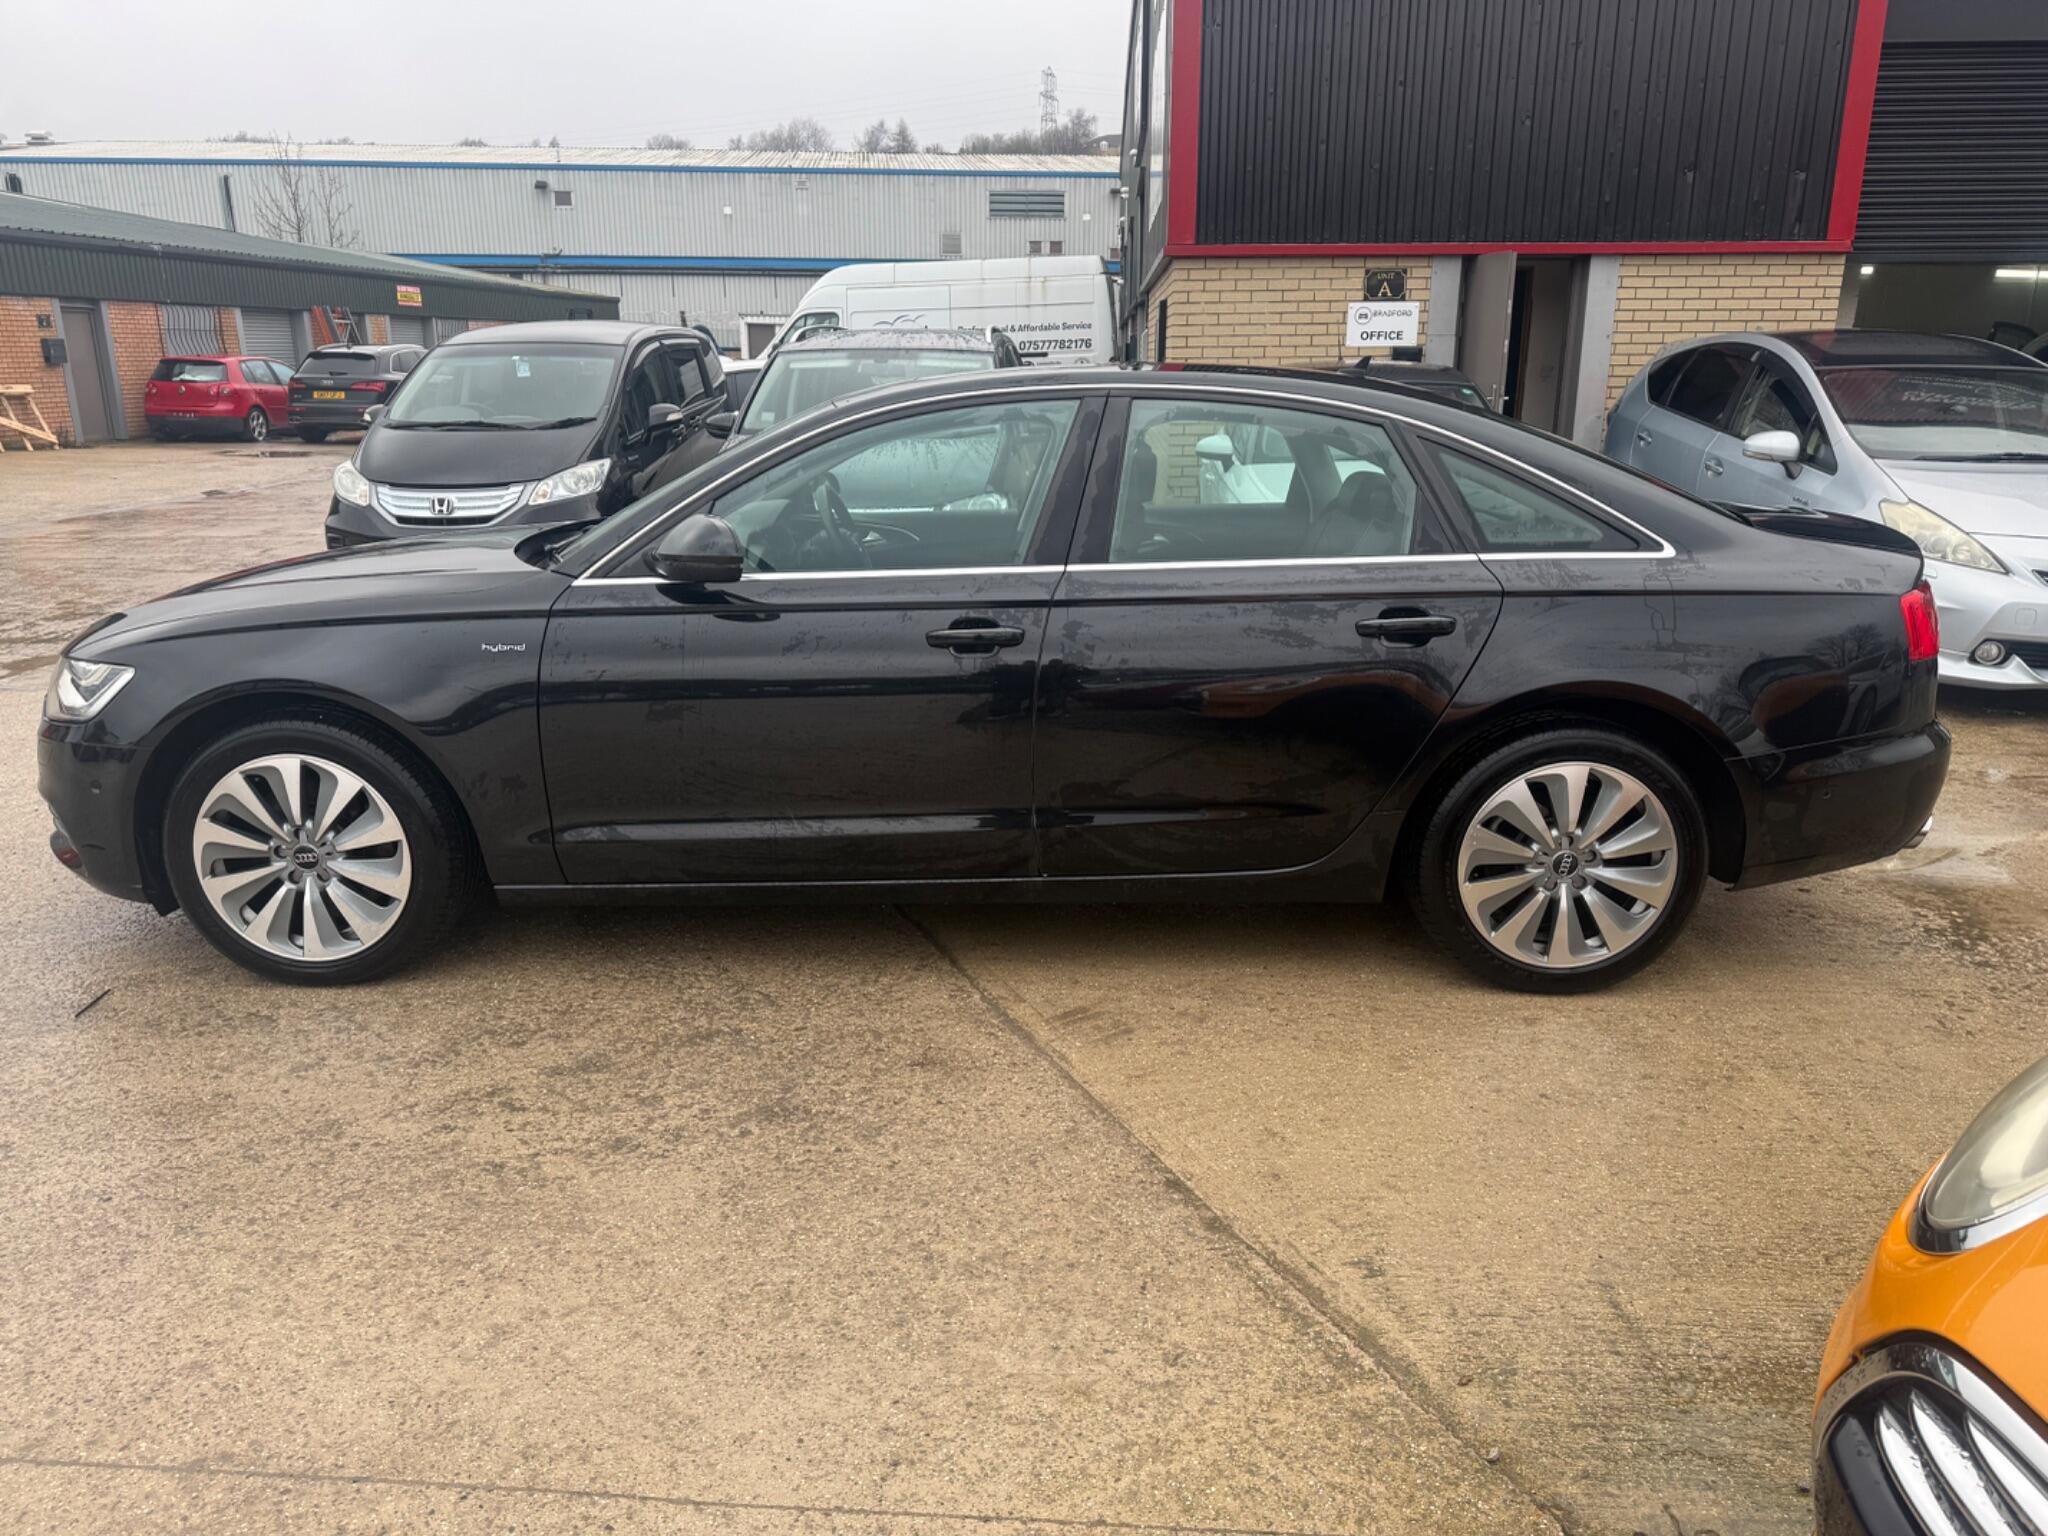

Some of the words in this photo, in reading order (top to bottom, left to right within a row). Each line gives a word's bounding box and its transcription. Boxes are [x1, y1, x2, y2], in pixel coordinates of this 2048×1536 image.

[1377, 272, 1395, 280] UNIT
[1377, 281, 1392, 297] A
[1373, 309, 1413, 317] BRADFORD
[1010, 324, 1016, 332] &
[1018, 322, 1060, 332] Affordable
[1062, 320, 1092, 330] Service
[1360, 330, 1404, 341] OFFICE
[1019, 338, 1092, 351] 07577782176
[481, 643, 526, 652] hybrid
